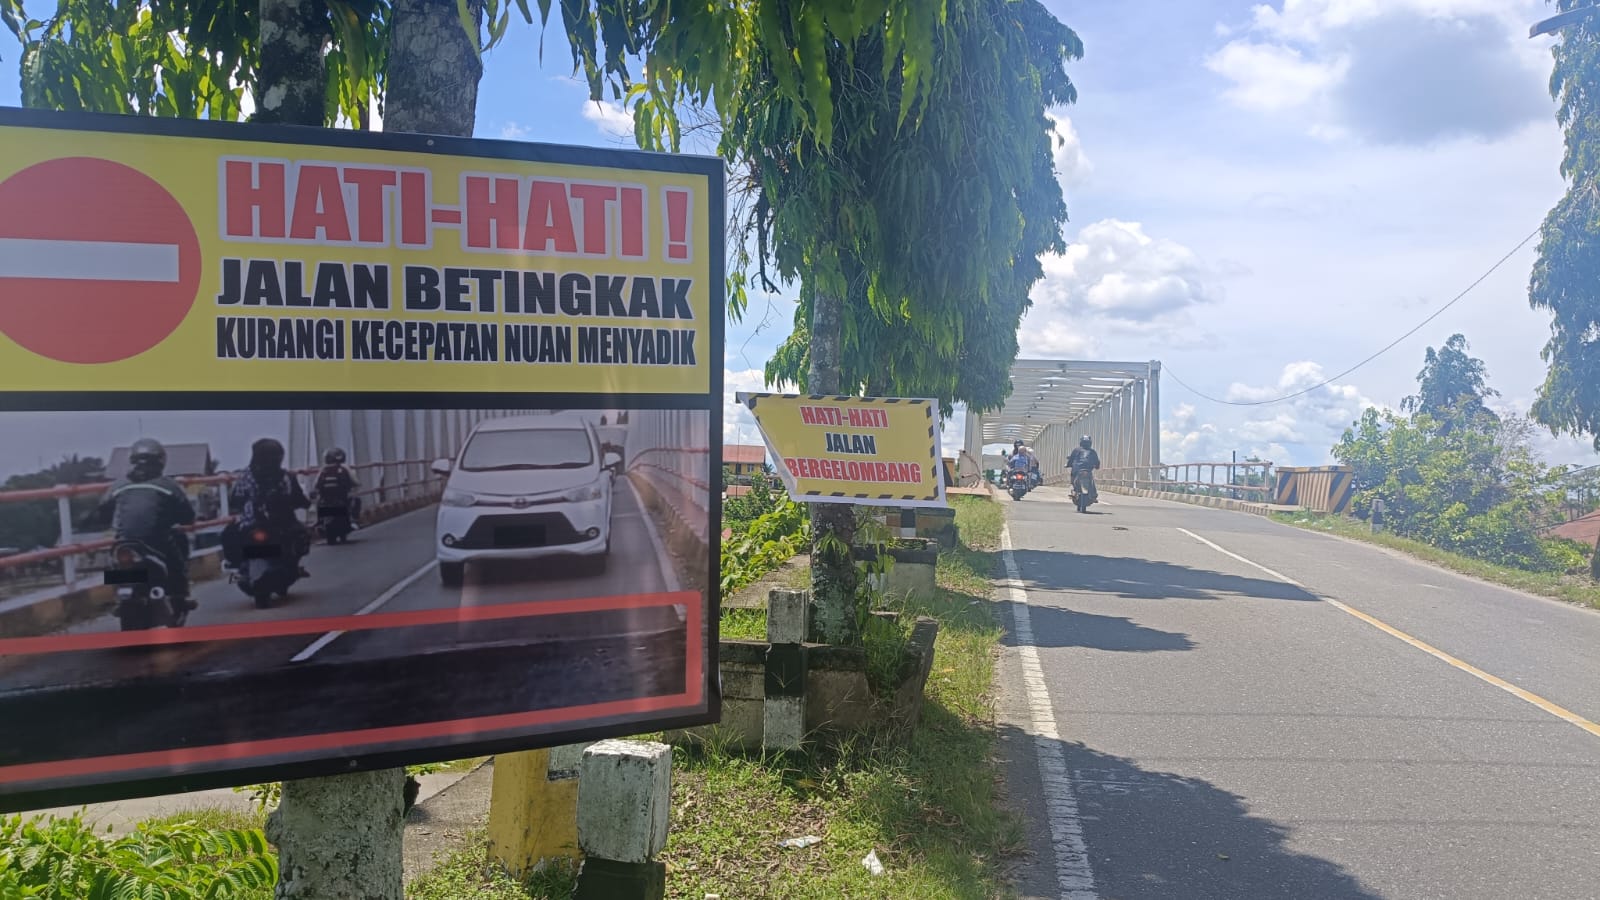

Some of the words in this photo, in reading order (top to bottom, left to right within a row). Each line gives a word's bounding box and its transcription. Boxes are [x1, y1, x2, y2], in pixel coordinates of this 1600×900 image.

[224, 160, 644, 257] HATI-HATI
[666, 190, 688, 259] !
[218, 258, 389, 309] JALAN
[404, 266, 693, 320] BETINGKAK
[216, 316, 345, 360] KURANGI
[352, 319, 498, 363] KECEPATAN
[504, 323, 571, 364] NUAN
[577, 326, 697, 366] MENYADIK
[801, 407, 888, 427] HATI-HATI
[826, 433, 876, 454] JALAN
[785, 458, 921, 483] BERGELOMBANG
